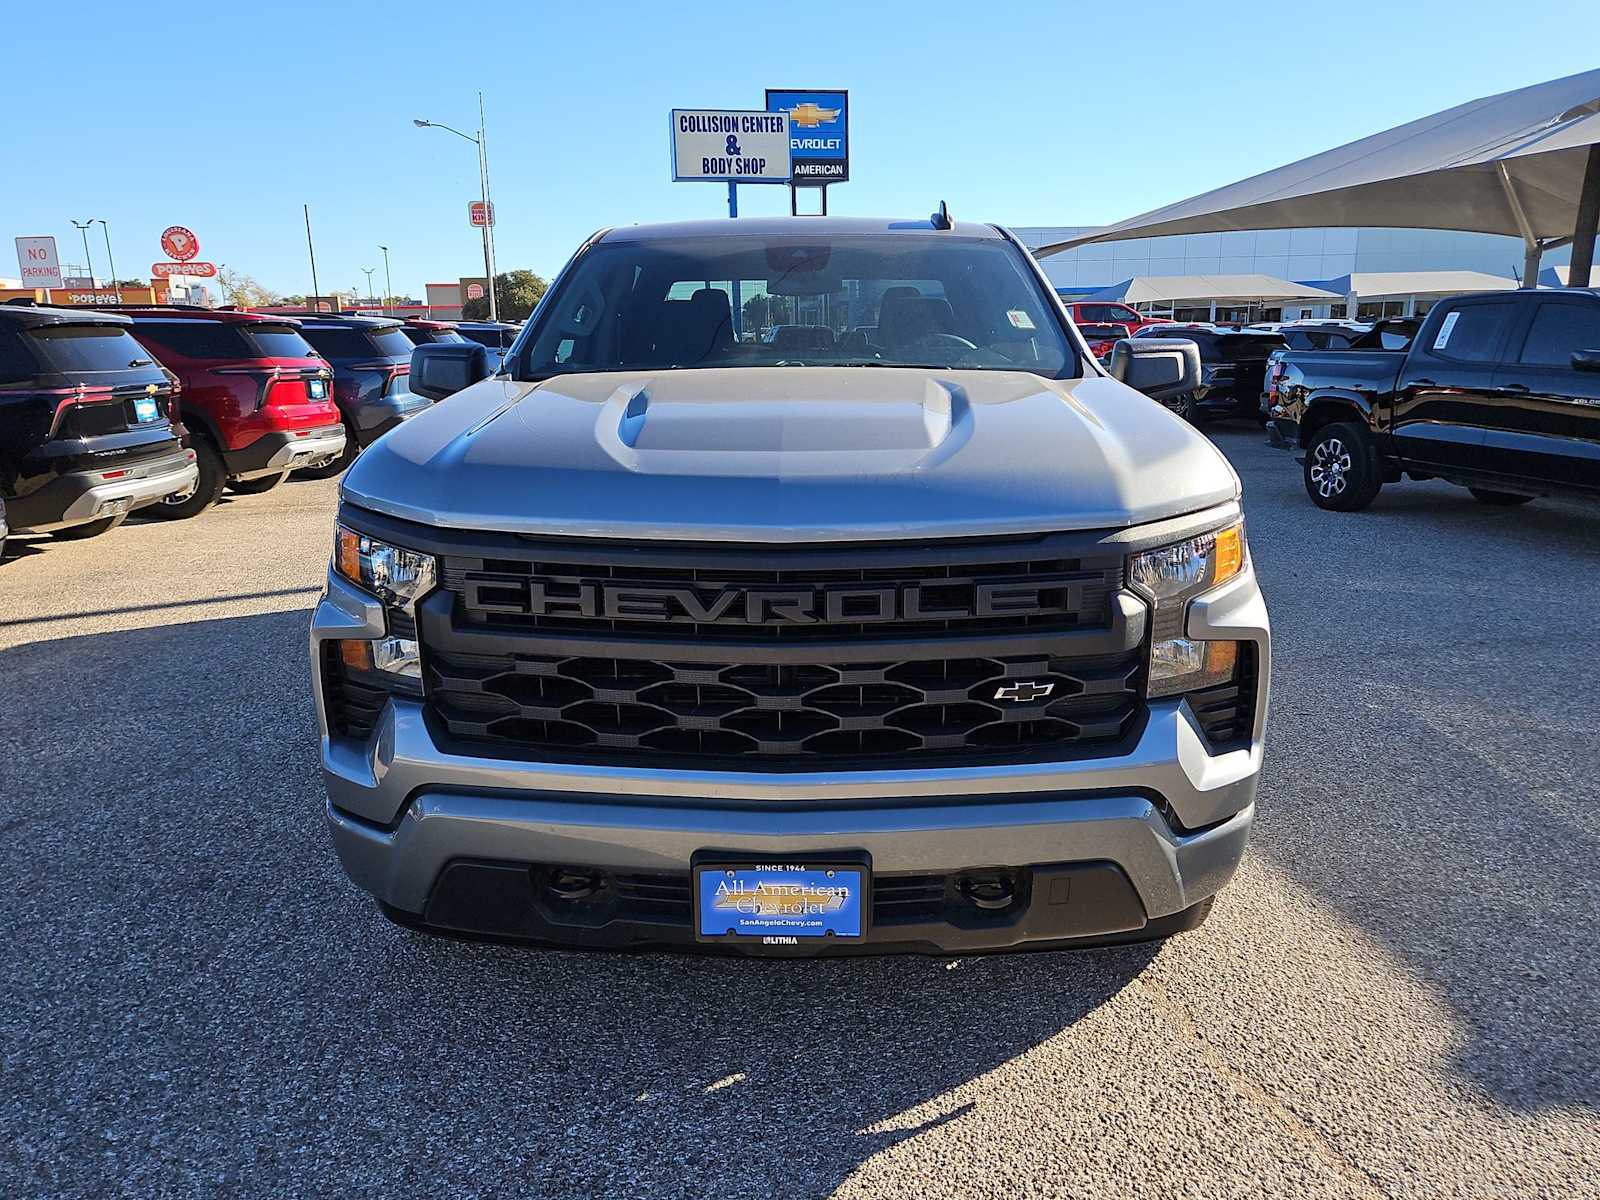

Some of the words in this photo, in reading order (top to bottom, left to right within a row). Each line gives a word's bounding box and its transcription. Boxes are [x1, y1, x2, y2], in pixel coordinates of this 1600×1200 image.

[680, 115, 739, 133] COLLISION
[742, 116, 784, 133] CENTER
[725, 134, 741, 156] &
[791, 138, 841, 149] EVROLET
[702, 157, 733, 174] BODY
[735, 157, 766, 174] SHOP
[794, 164, 843, 175] AMERICAN
[28, 248, 47, 260] NO
[23, 266, 59, 277] PARKING
[463, 572, 1088, 625] CHEVROLET
[755, 864, 783, 872] SINCE
[714, 880, 745, 896] All
[753, 881, 850, 897] American
[736, 897, 826, 915] Chevrolet
[740, 919, 823, 927] SanAngeloChevy.com
[771, 936, 798, 945] LITHIA
